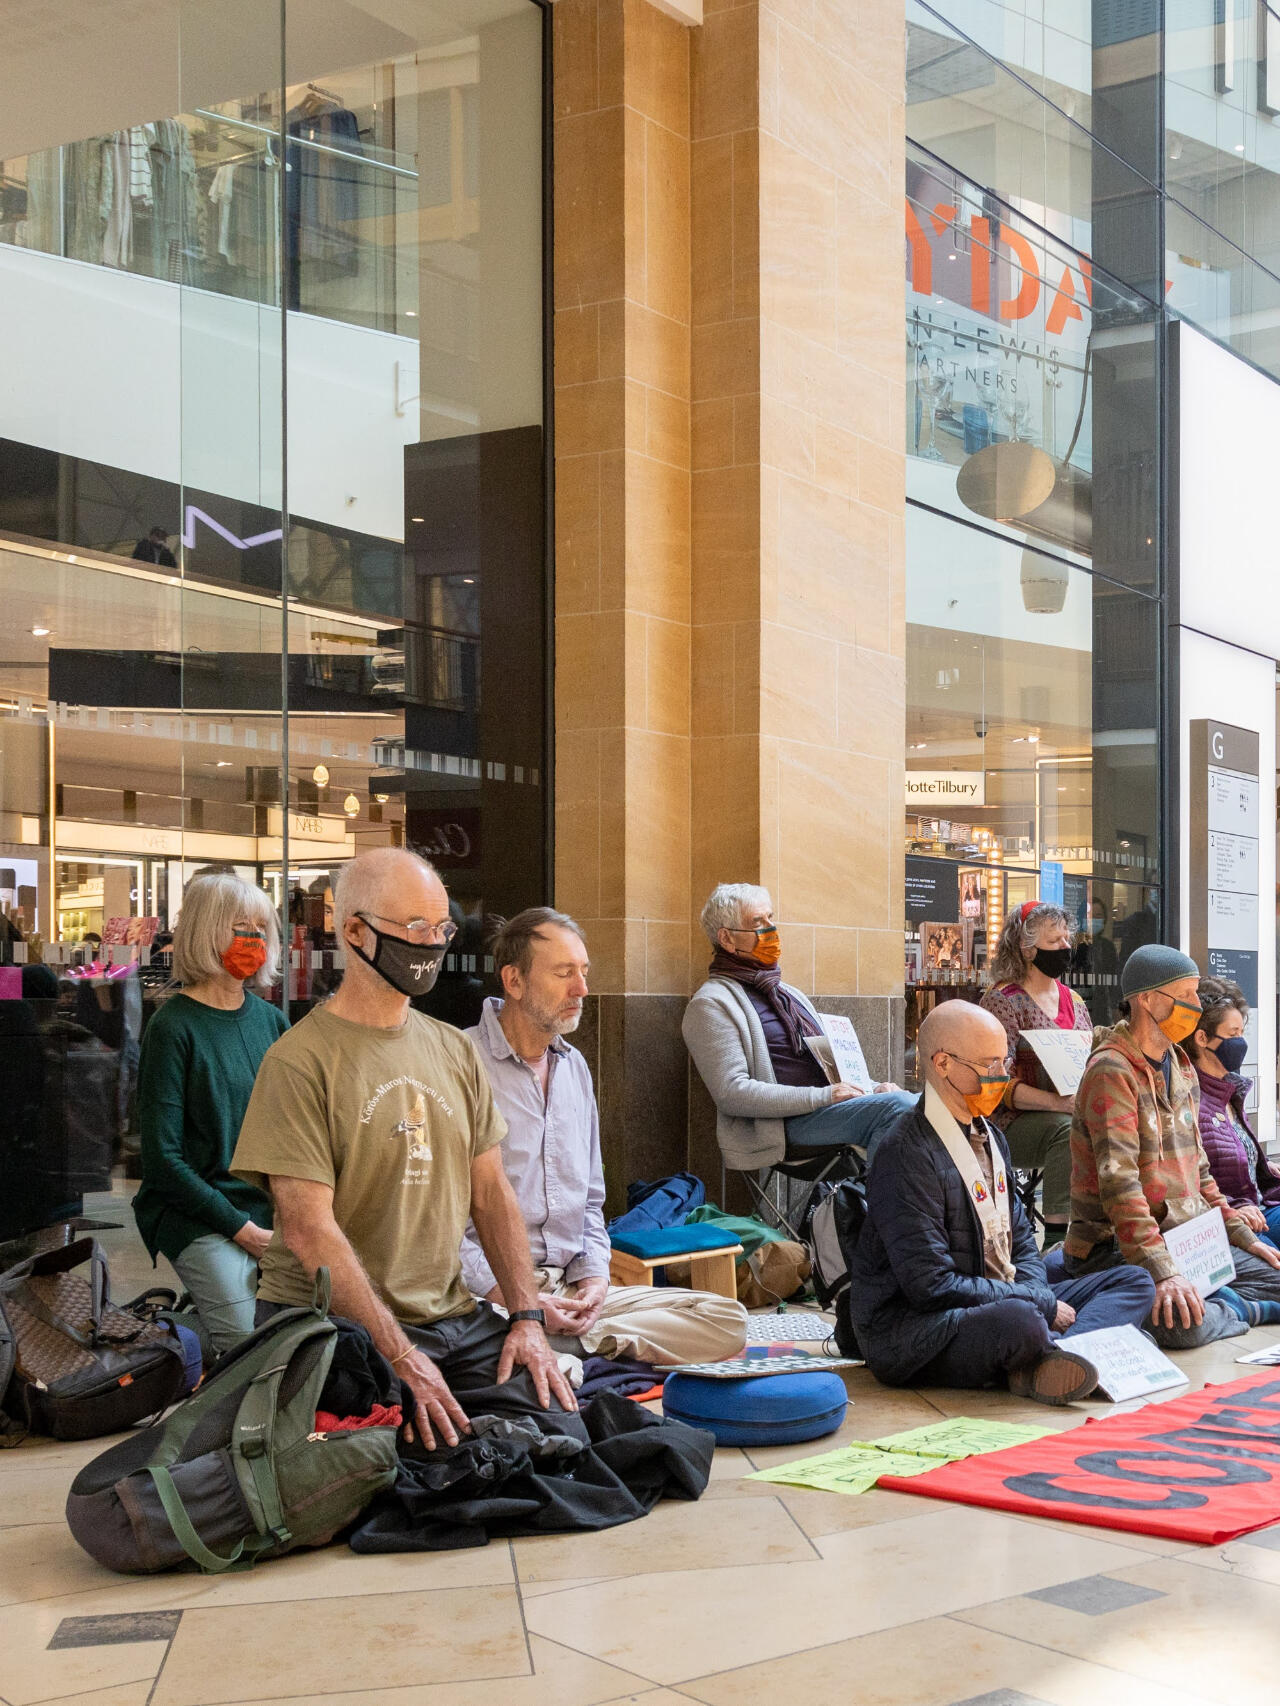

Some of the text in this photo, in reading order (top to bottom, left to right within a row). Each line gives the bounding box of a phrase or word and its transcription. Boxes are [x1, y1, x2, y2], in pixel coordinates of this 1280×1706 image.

[953, 320, 1060, 375] LEWIS
[919, 354, 1018, 394] ARTNERS
[1212, 731, 1224, 760] G
[296, 816, 323, 834] NARS
[1210, 952, 1216, 965] G
[437, 1095, 455, 1118] Park
[1174, 1223, 1221, 1257] LIVE SIMPLY
[1210, 1250, 1228, 1269] LIVE
